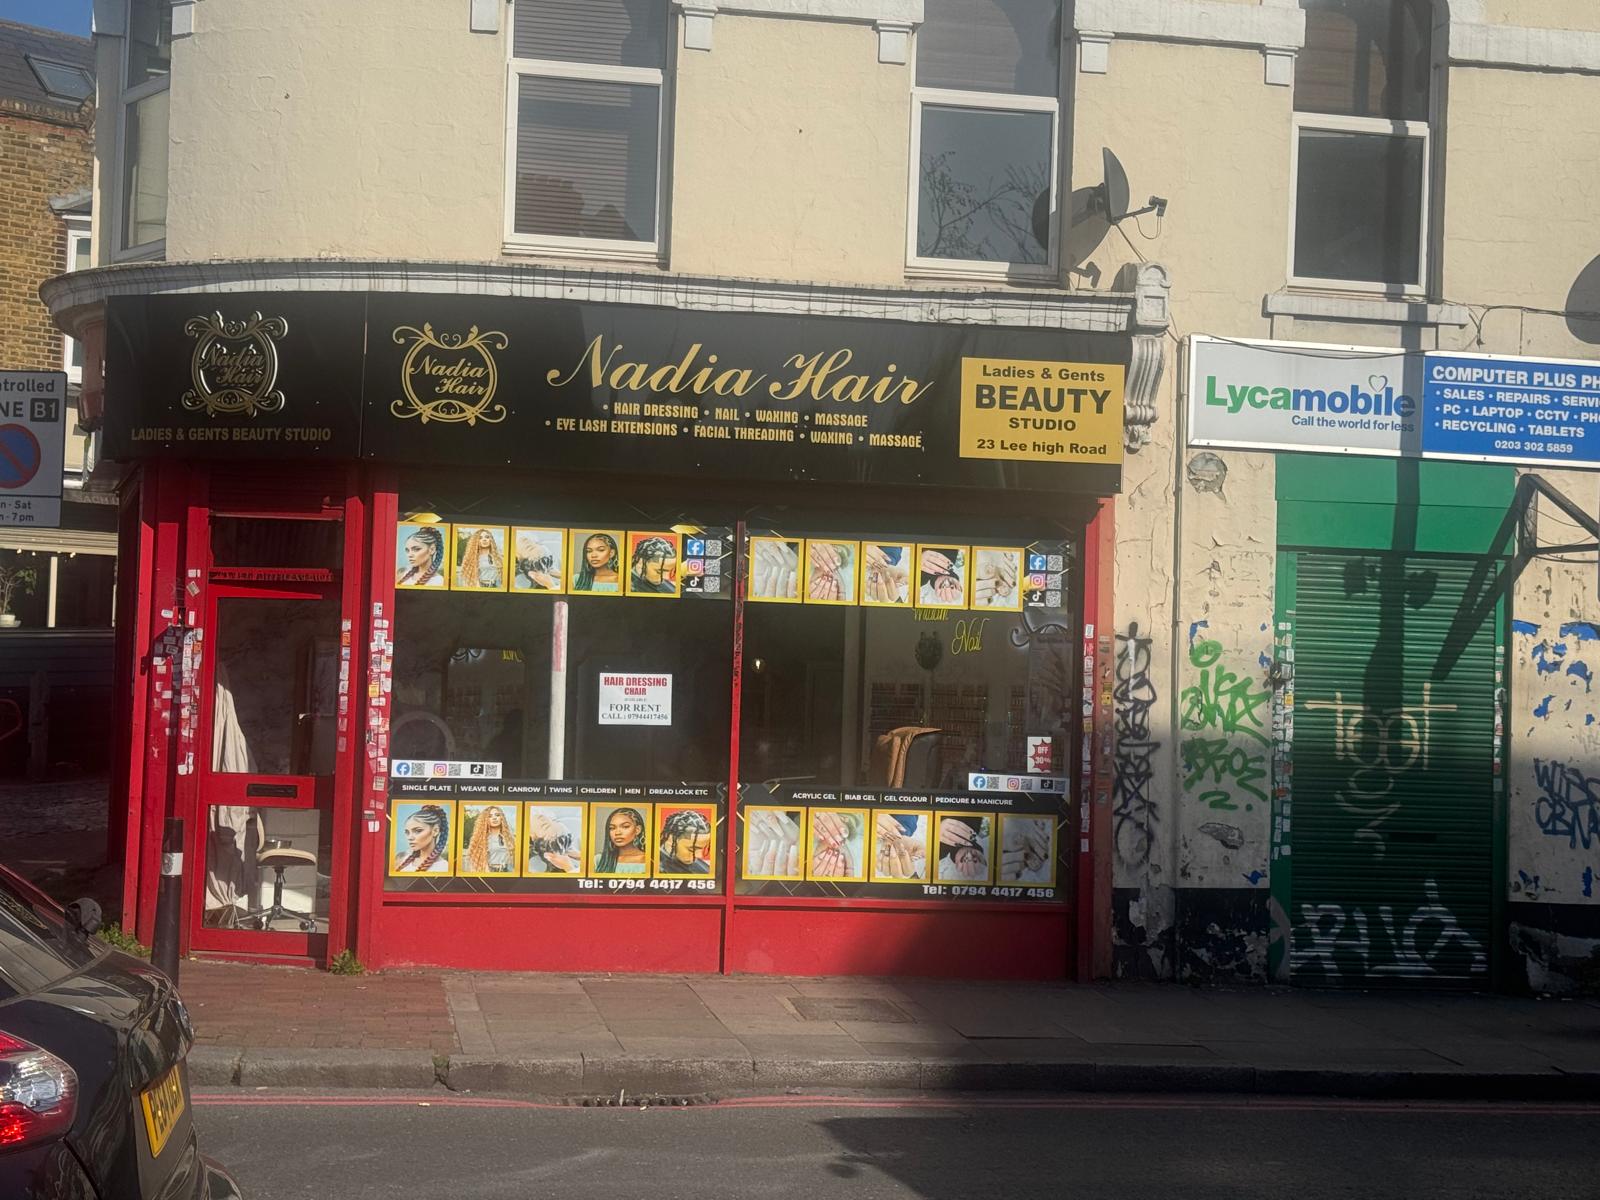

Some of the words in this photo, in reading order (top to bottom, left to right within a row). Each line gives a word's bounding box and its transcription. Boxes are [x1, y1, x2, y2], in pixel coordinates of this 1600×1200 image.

[409, 355, 489, 378] Nadia
[547, 334, 767, 397] Nadia
[769, 348, 935, 405] Hair
[982, 364, 1036, 379] Ladies
[1040, 367, 1053, 380] &
[1058, 368, 1106, 382] Gents
[1432, 365, 1528, 386] COMPUTER
[1533, 371, 1577, 388] PLUS
[0, 378, 55, 393] trolled
[434, 377, 489, 395] Hair
[975, 383, 1112, 415] BEAUTY
[1206, 374, 1417, 418] Lycamobile
[1443, 388, 1485, 401] SALES
[1496, 391, 1551, 405] REPAIRS
[1562, 395, 1600, 408] SERVI
[34, 401, 57, 419] B1
[613, 401, 641, 416] HAIR
[643, 403, 699, 419] DRESSING
[715, 407, 740, 421] NAIL
[755, 409, 799, 424] WAXING
[815, 413, 869, 428] MASSAGE
[1442, 404, 1461, 415] PC
[1472, 405, 1524, 419] LAPTOP
[1535, 409, 1570, 422] CCTV
[1008, 417, 1077, 432] STUDIO
[1291, 414, 1315, 427] Call
[1316, 416, 1337, 428] the
[1338, 418, 1371, 430] world
[1391, 421, 1415, 433] less
[1442, 419, 1516, 434] RECYCLING
[1528, 424, 1585, 438] TABLETS
[131, 428, 172, 441] LADIES
[176, 428, 185, 441] &
[188, 428, 230, 441] GENTS
[232, 428, 282, 441] BEAUTY
[284, 428, 332, 441] STUDIO
[556, 418, 576, 431] EYE
[579, 419, 608, 433] LASH
[611, 421, 678, 436] EXTENSIONS
[694, 425, 732, 439] FACIAL
[734, 426, 795, 442] THREADING
[810, 430, 853, 445] WAXING
[977, 438, 995, 450] 23
[1000, 440, 1028, 451] Lee
[1032, 441, 1065, 456] high
[1069, 443, 1107, 455] Road
[1494, 440, 1521, 450] 0203
[1524, 441, 1544, 452] 302
[1546, 443, 1574, 454] 5859
[14, 500, 32, 510] Sat
[604, 676, 624, 686] HAIR
[626, 677, 667, 686] DRESSING
[624, 687, 647, 695] CHAIR
[609, 703, 631, 712] FOR
[633, 704, 662, 713] RENT
[401, 784, 427, 792] SINGLE
[549, 786, 573, 794] TWINS
[580, 787, 617, 795] CHILDREN
[649, 788, 674, 796] DREAD
[674, 788, 694, 796] LOCK
[792, 791, 822, 800] ACRYLIC
[844, 793, 862, 801] BIAB
[884, 794, 898, 802] GEL
[898, 795, 928, 803] COLOUR
[935, 796, 970, 804] PEDICURE
[976, 798, 1014, 806] MANICURE
[577, 878, 604, 890] Tel:
[608, 879, 646, 889] 0794
[649, 879, 684, 890] 4417
[687, 880, 716, 890] 456
[921, 883, 948, 896] Tel:
[951, 885, 987, 896] 0794
[990, 886, 1024, 897] 4417
[1026, 888, 1055, 898] 456
